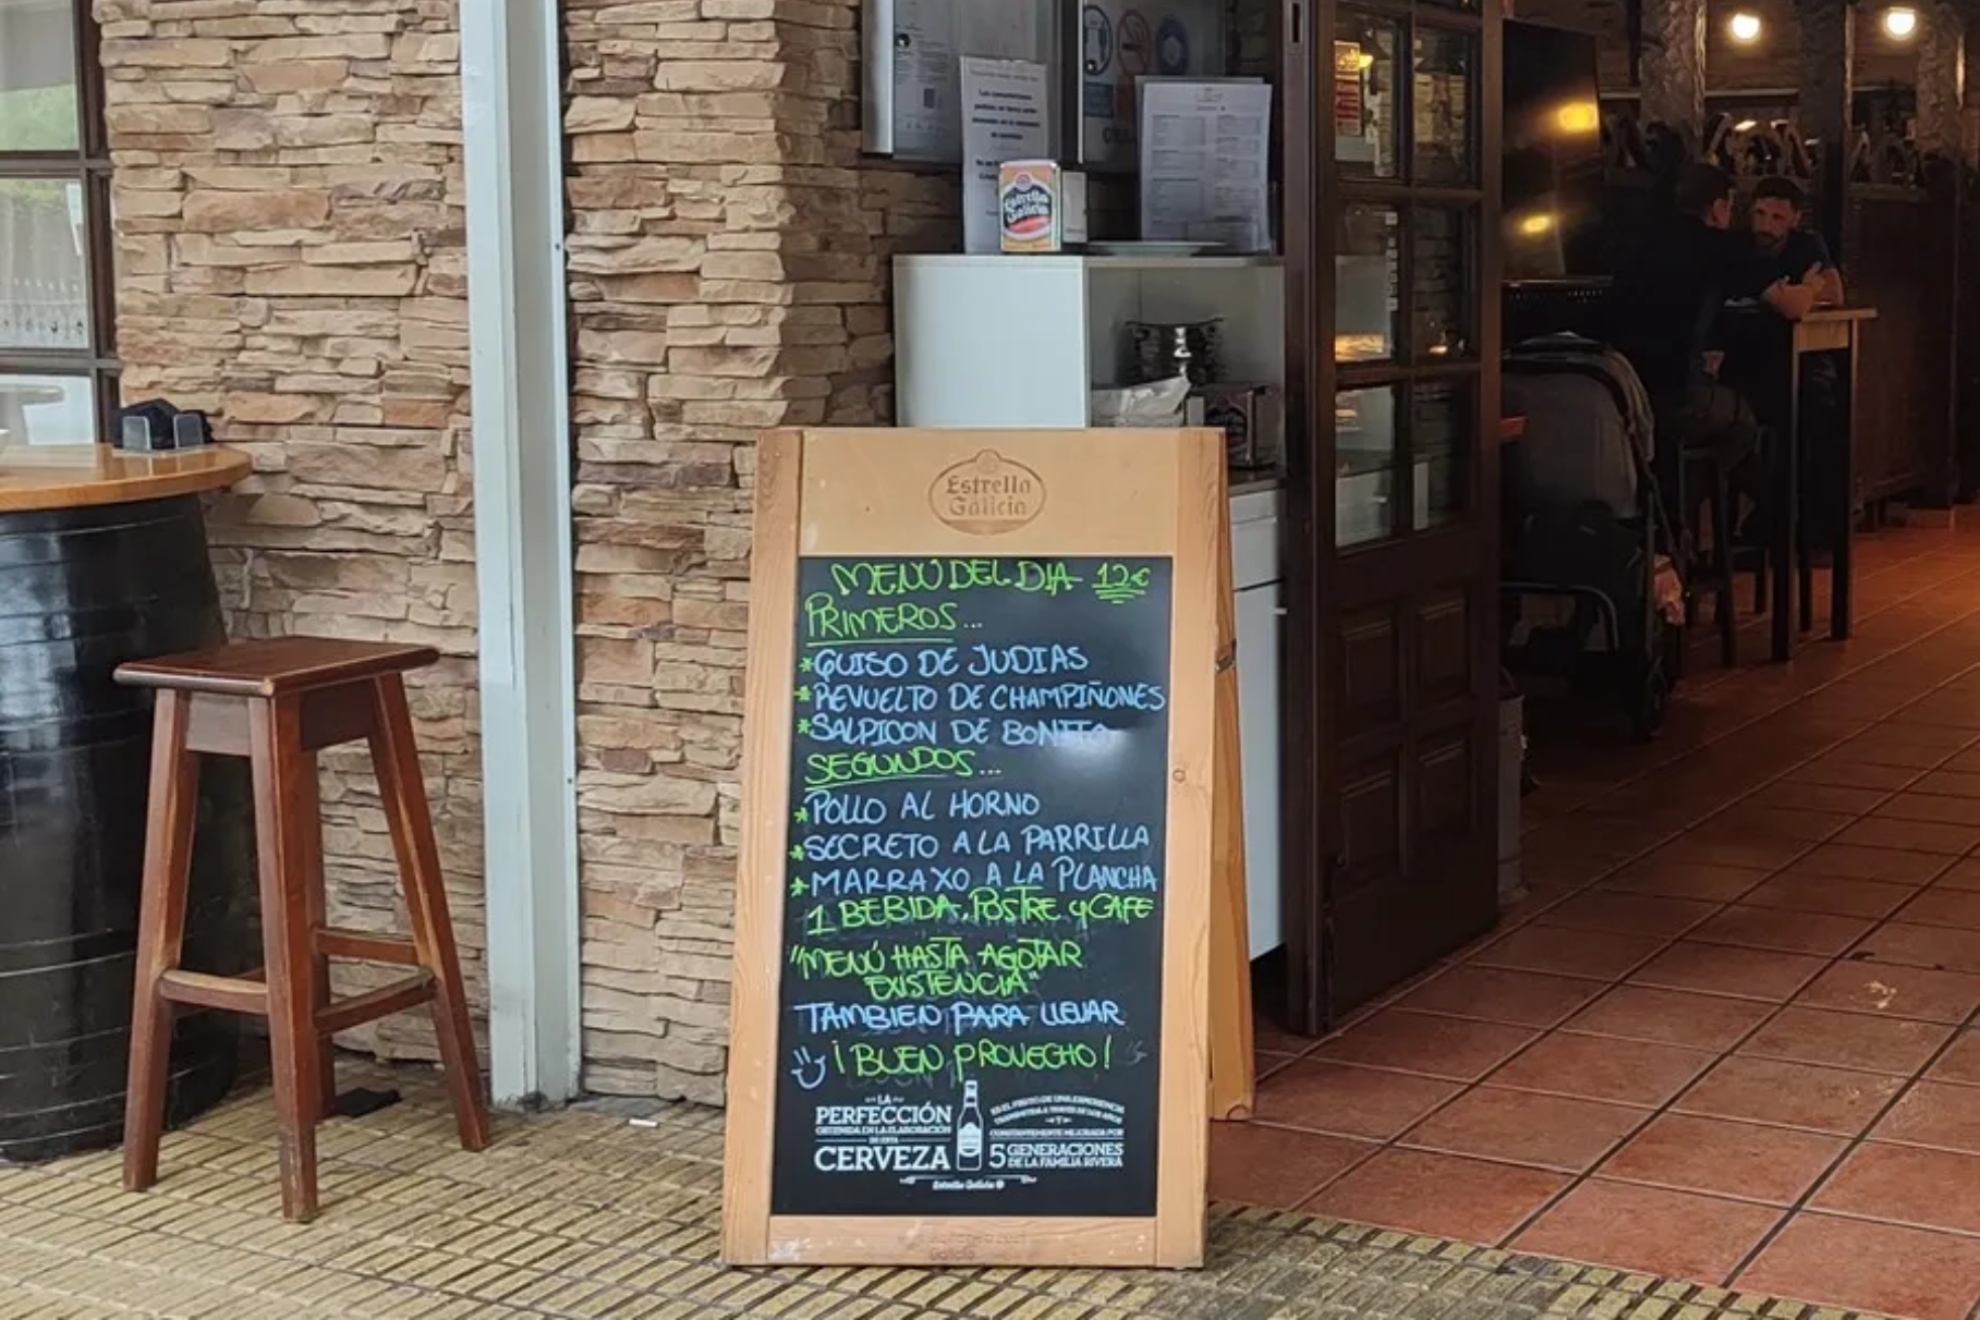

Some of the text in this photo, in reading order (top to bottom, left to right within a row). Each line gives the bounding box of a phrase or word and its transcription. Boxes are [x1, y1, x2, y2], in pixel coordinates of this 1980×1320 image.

[946, 475, 1031, 494] Estrella
[949, 496, 1026, 516] Galicia
[948, 558, 1011, 589] DEL
[1091, 563, 1151, 603] 12€
[814, 645, 1089, 681] GUISO DE JUDIAS
[814, 681, 1165, 711] REVUELTO DE CHAMPIÑONES
[810, 713, 937, 746] SALPICON
[951, 718, 990, 745] DE
[803, 789, 1040, 824] POLLO AL HORNO
[803, 824, 1150, 861] SECRETO A LA PARRILLA
[811, 856, 1158, 896] MARRAXO A LA PLANCHA
[806, 904, 837, 936] 1
[968, 887, 1061, 924] POSTRE
[891, 937, 970, 970] HASTA
[977, 938, 1083, 968] AGOTAR
[794, 1003, 942, 1034] TAMBIEN
[950, 1002, 1029, 1035] PARA
[815, 1101, 952, 1125] PERFECCIÓN
[877, 1094, 892, 1105] LA
[814, 1146, 951, 1171] CERVEZA
[989, 1143, 1006, 1168] 5
[1007, 1143, 1124, 1156] GENERACIONES
[1008, 1157, 1123, 1167] DE LA FAMILIA RIVERA
